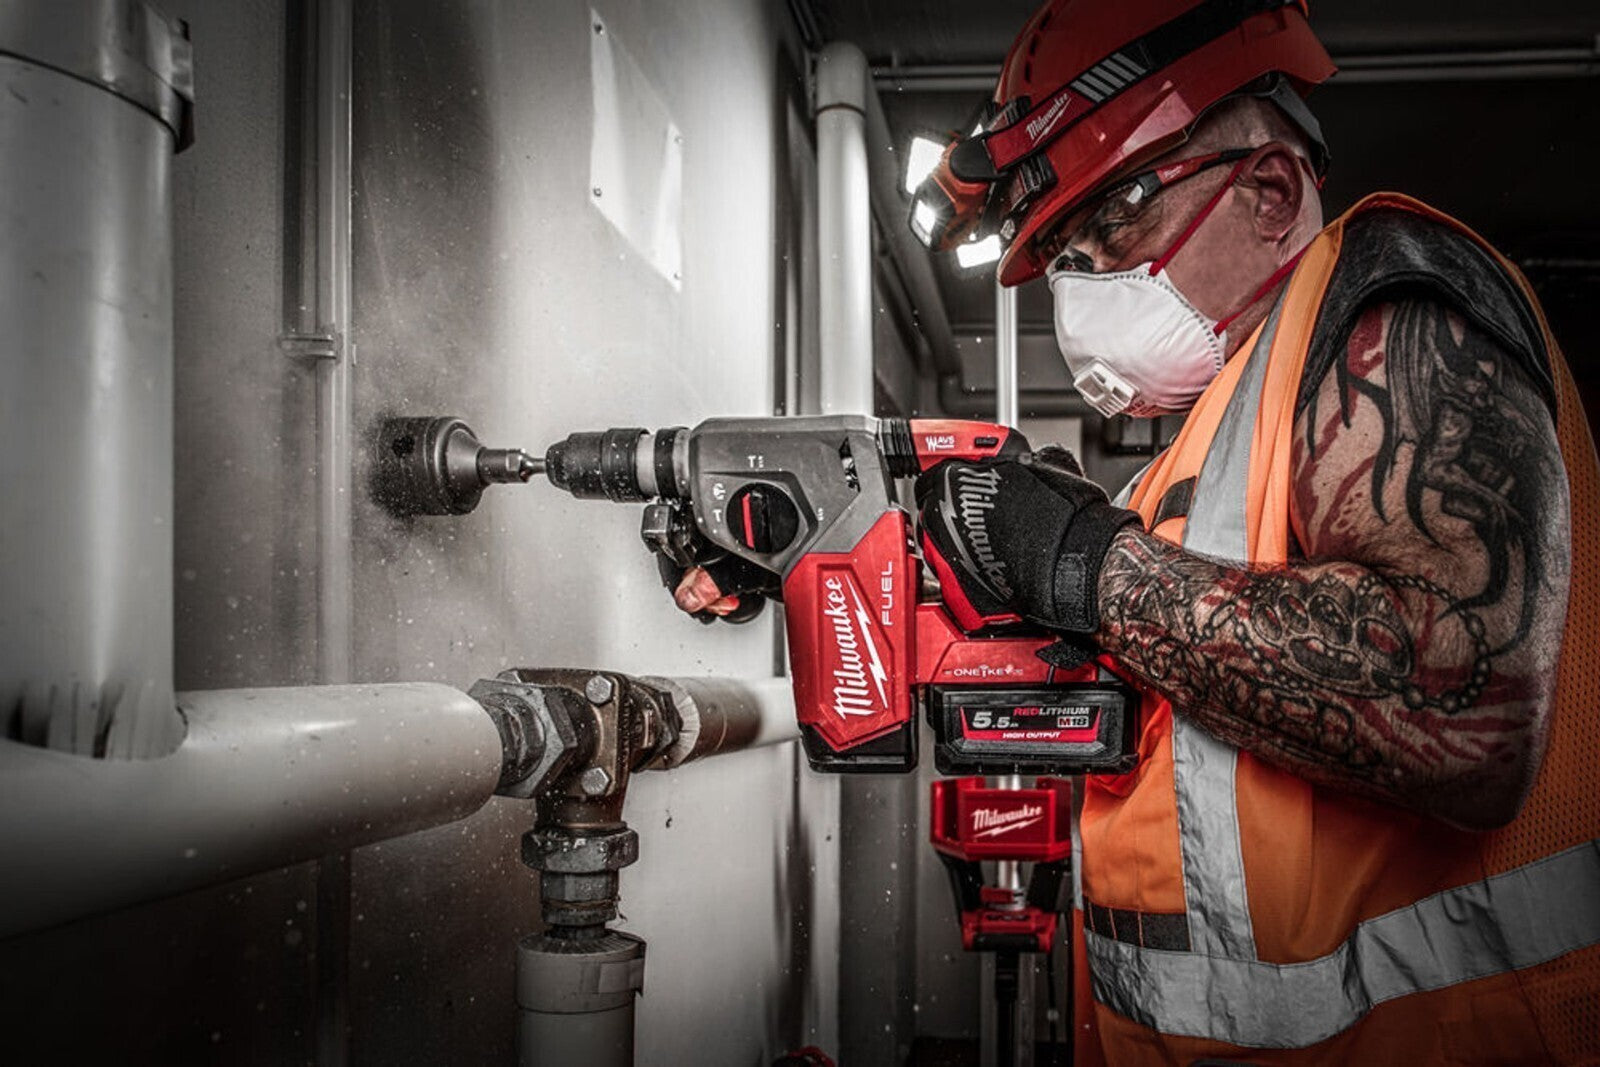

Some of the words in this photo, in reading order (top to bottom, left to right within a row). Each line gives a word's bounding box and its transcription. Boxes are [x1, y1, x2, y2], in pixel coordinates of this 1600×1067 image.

[1026, 93, 1067, 140] Milwaukee
[881, 561, 893, 626] FUEL
[824, 576, 876, 720] Milwaukee
[1013, 707, 1089, 716] REDLITHIUM
[1057, 716, 1089, 728] M18
[970, 804, 1042, 831] Milwaukee
